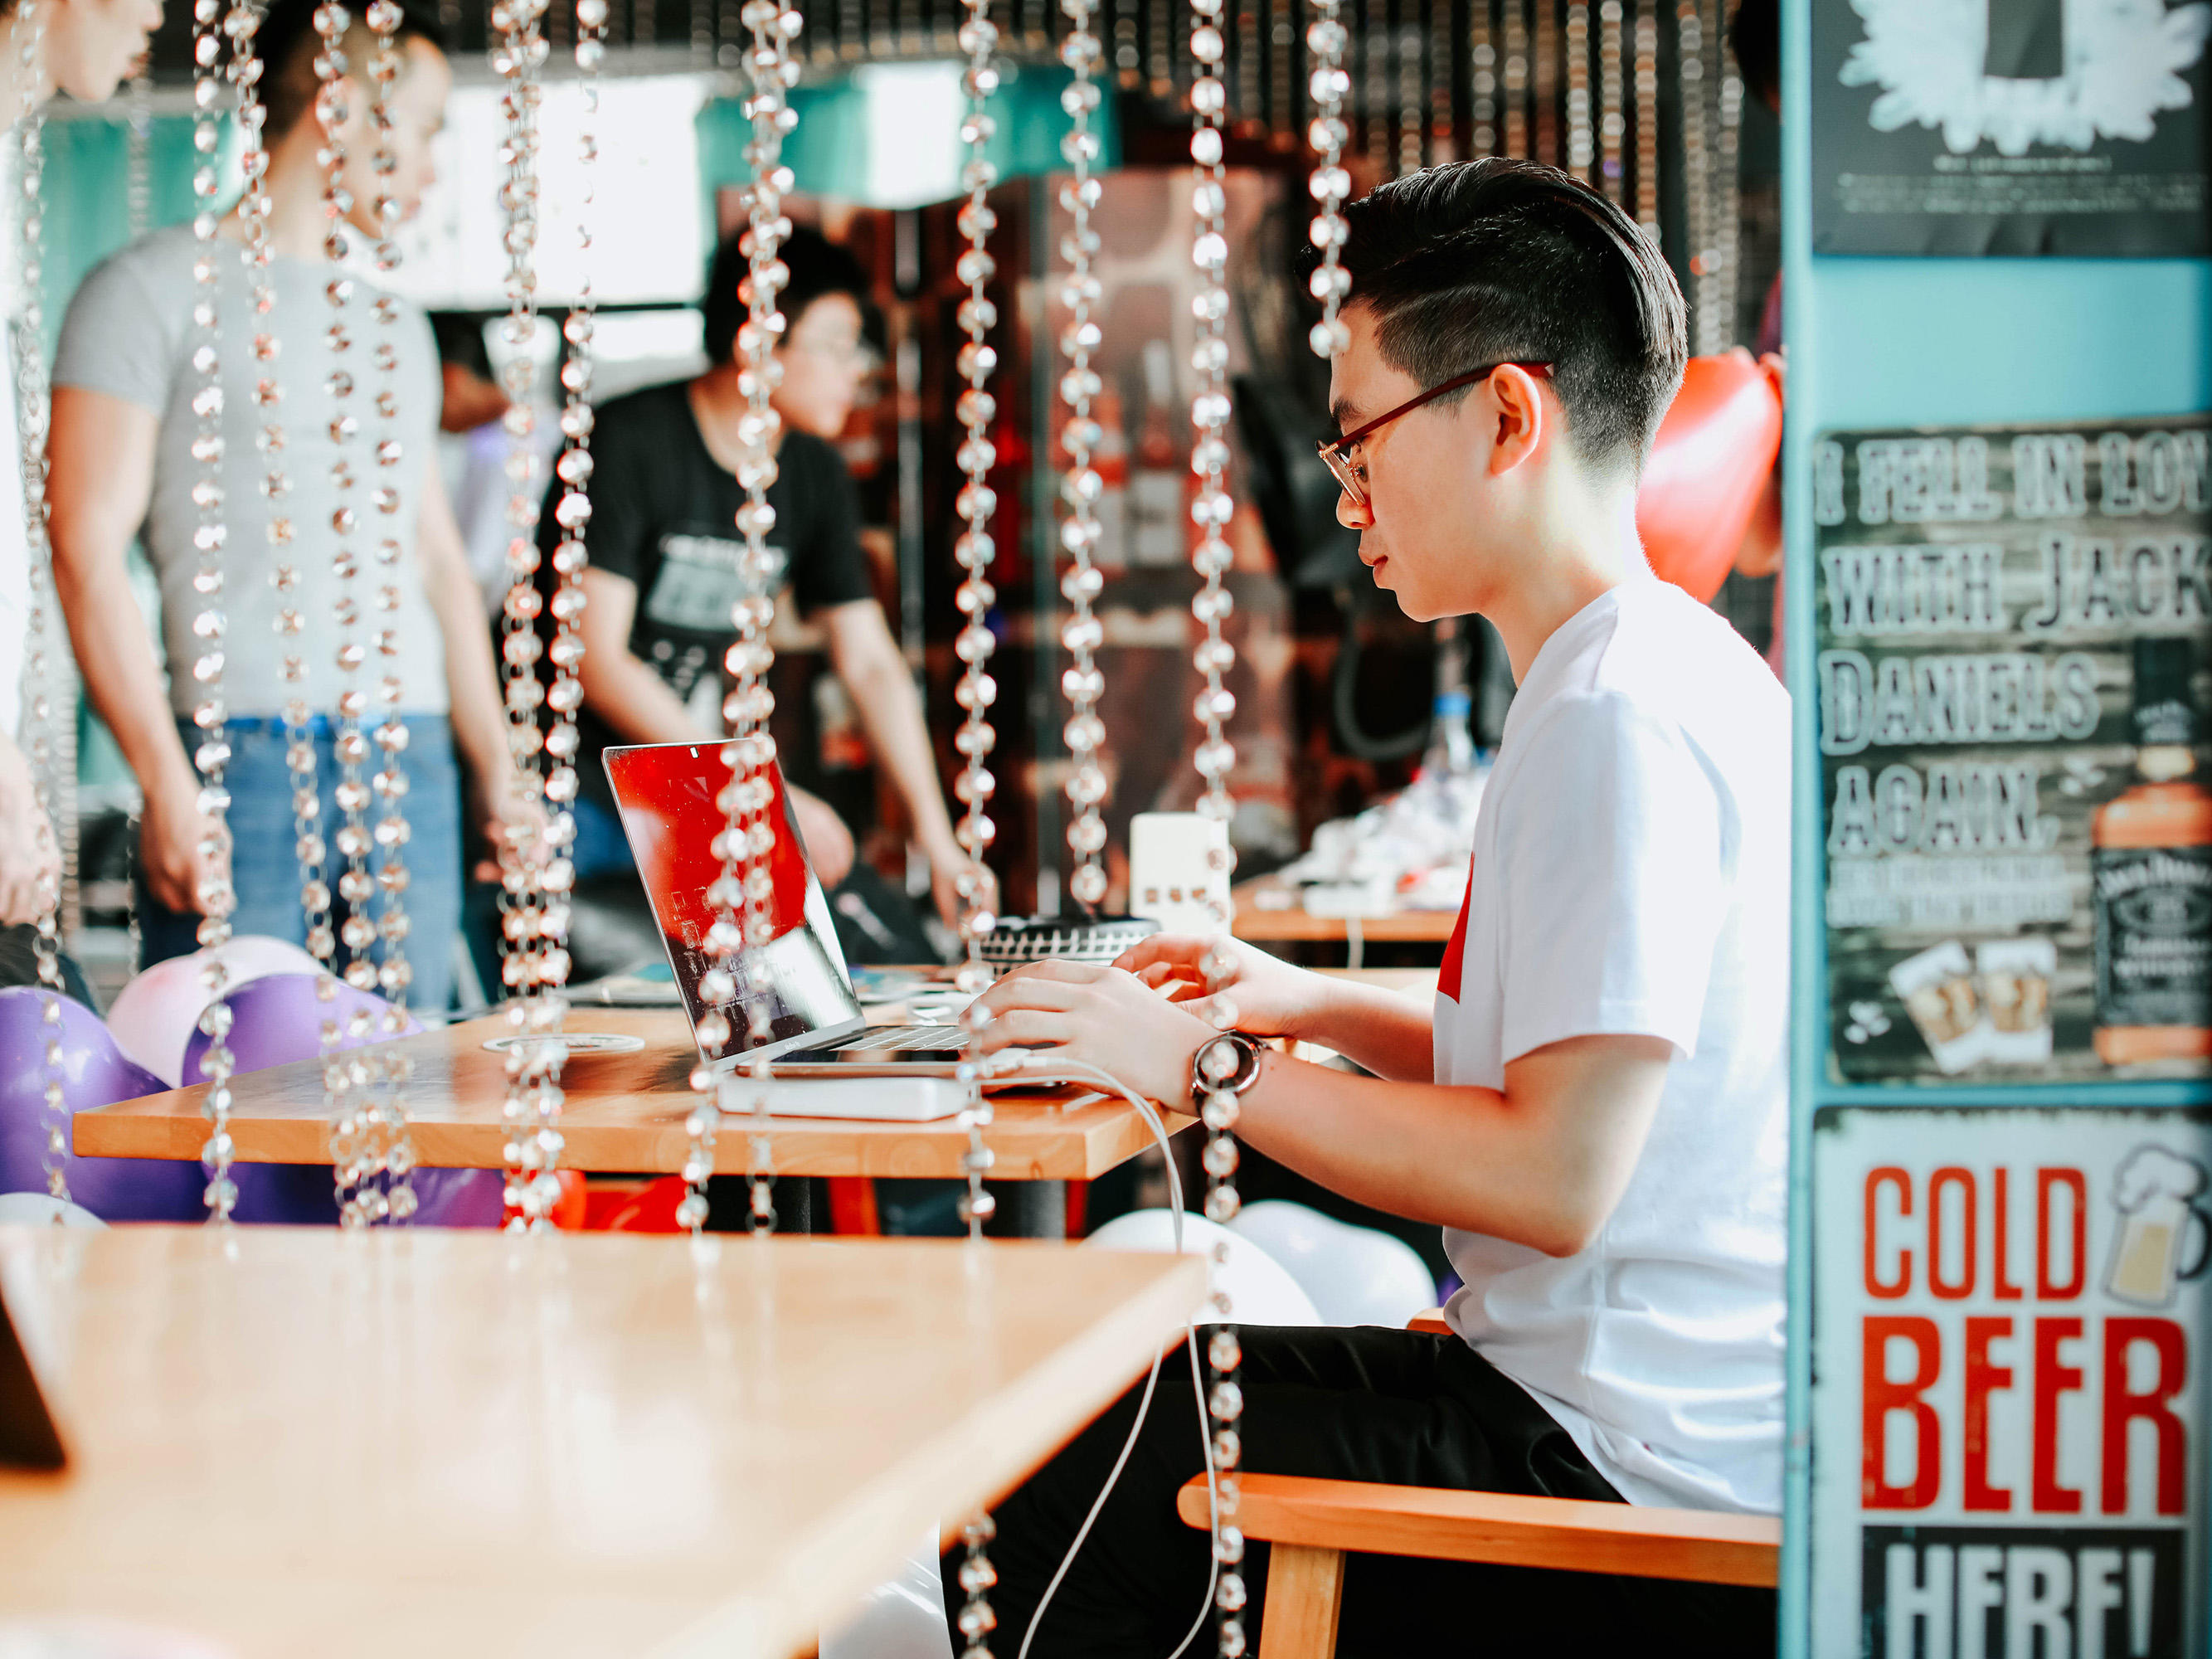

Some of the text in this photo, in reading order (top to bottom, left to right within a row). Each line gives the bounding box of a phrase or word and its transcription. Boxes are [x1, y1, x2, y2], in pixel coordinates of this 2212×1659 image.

[1814, 440, 1846, 526] I
[1856, 436, 2003, 525] FELL
[2011, 434, 2087, 519] IN
[1821, 531, 2212, 637] WITH JACK
[1818, 649, 2101, 755] DANIELS
[1864, 1166, 2087, 1301] COLD
[1860, 1316, 2187, 1516] BEER
